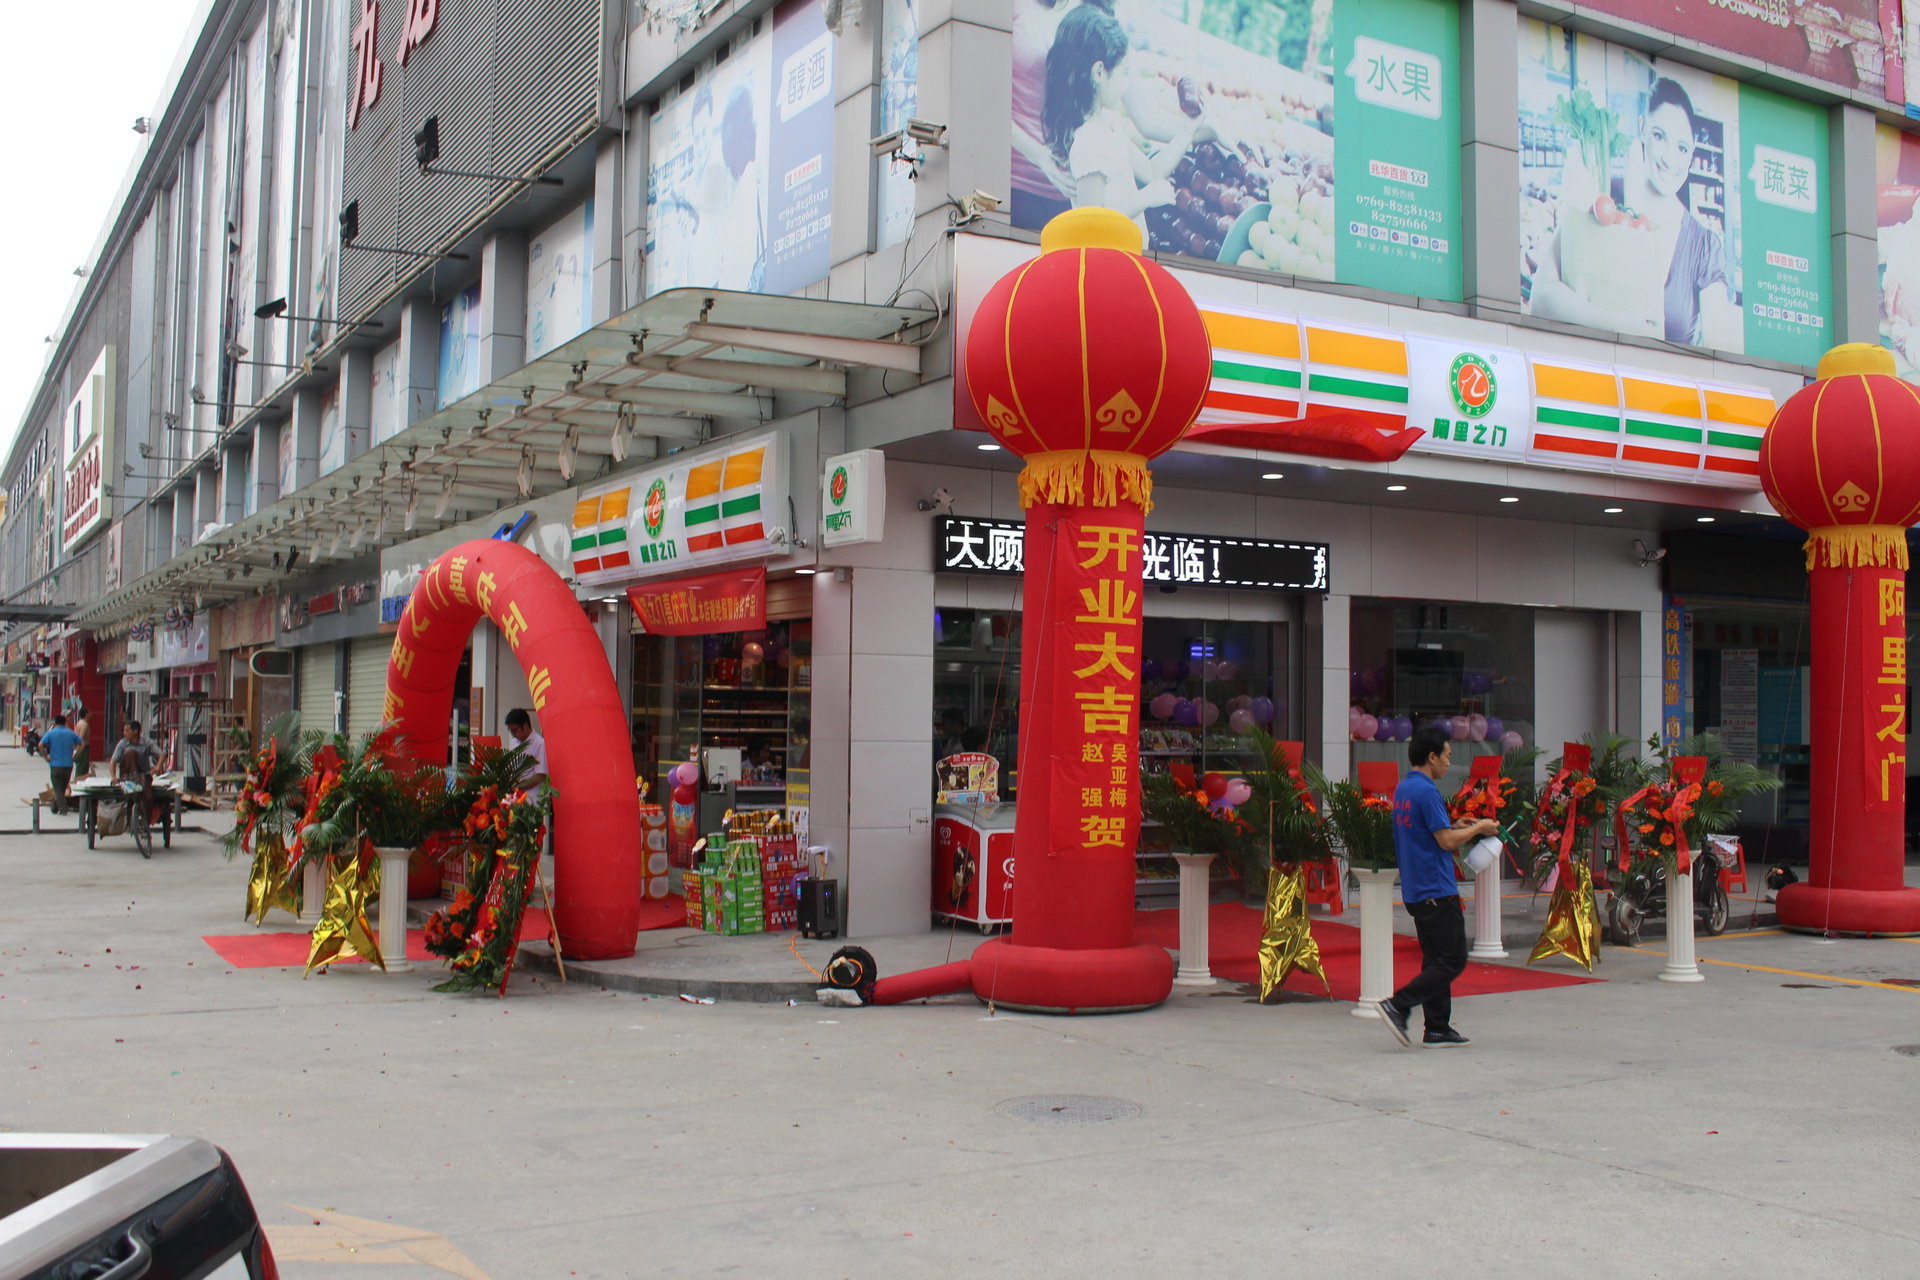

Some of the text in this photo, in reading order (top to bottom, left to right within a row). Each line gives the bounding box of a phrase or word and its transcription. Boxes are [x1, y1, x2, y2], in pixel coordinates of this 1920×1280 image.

[788, 46, 826, 104] 醇酒
[1366, 54, 1432, 103] 水果
[1762, 157, 1811, 202] 蔬菜
[1356, 195, 1443, 223] 0769-82581133
[1371, 209, 1428, 232] 82759666
[1432, 417, 1508, 448] 阿里之门
[1073, 524, 1139, 735] 开业大吉
[1109, 743, 1128, 808] 吴亚梅
[1080, 813, 1126, 849] 贺
